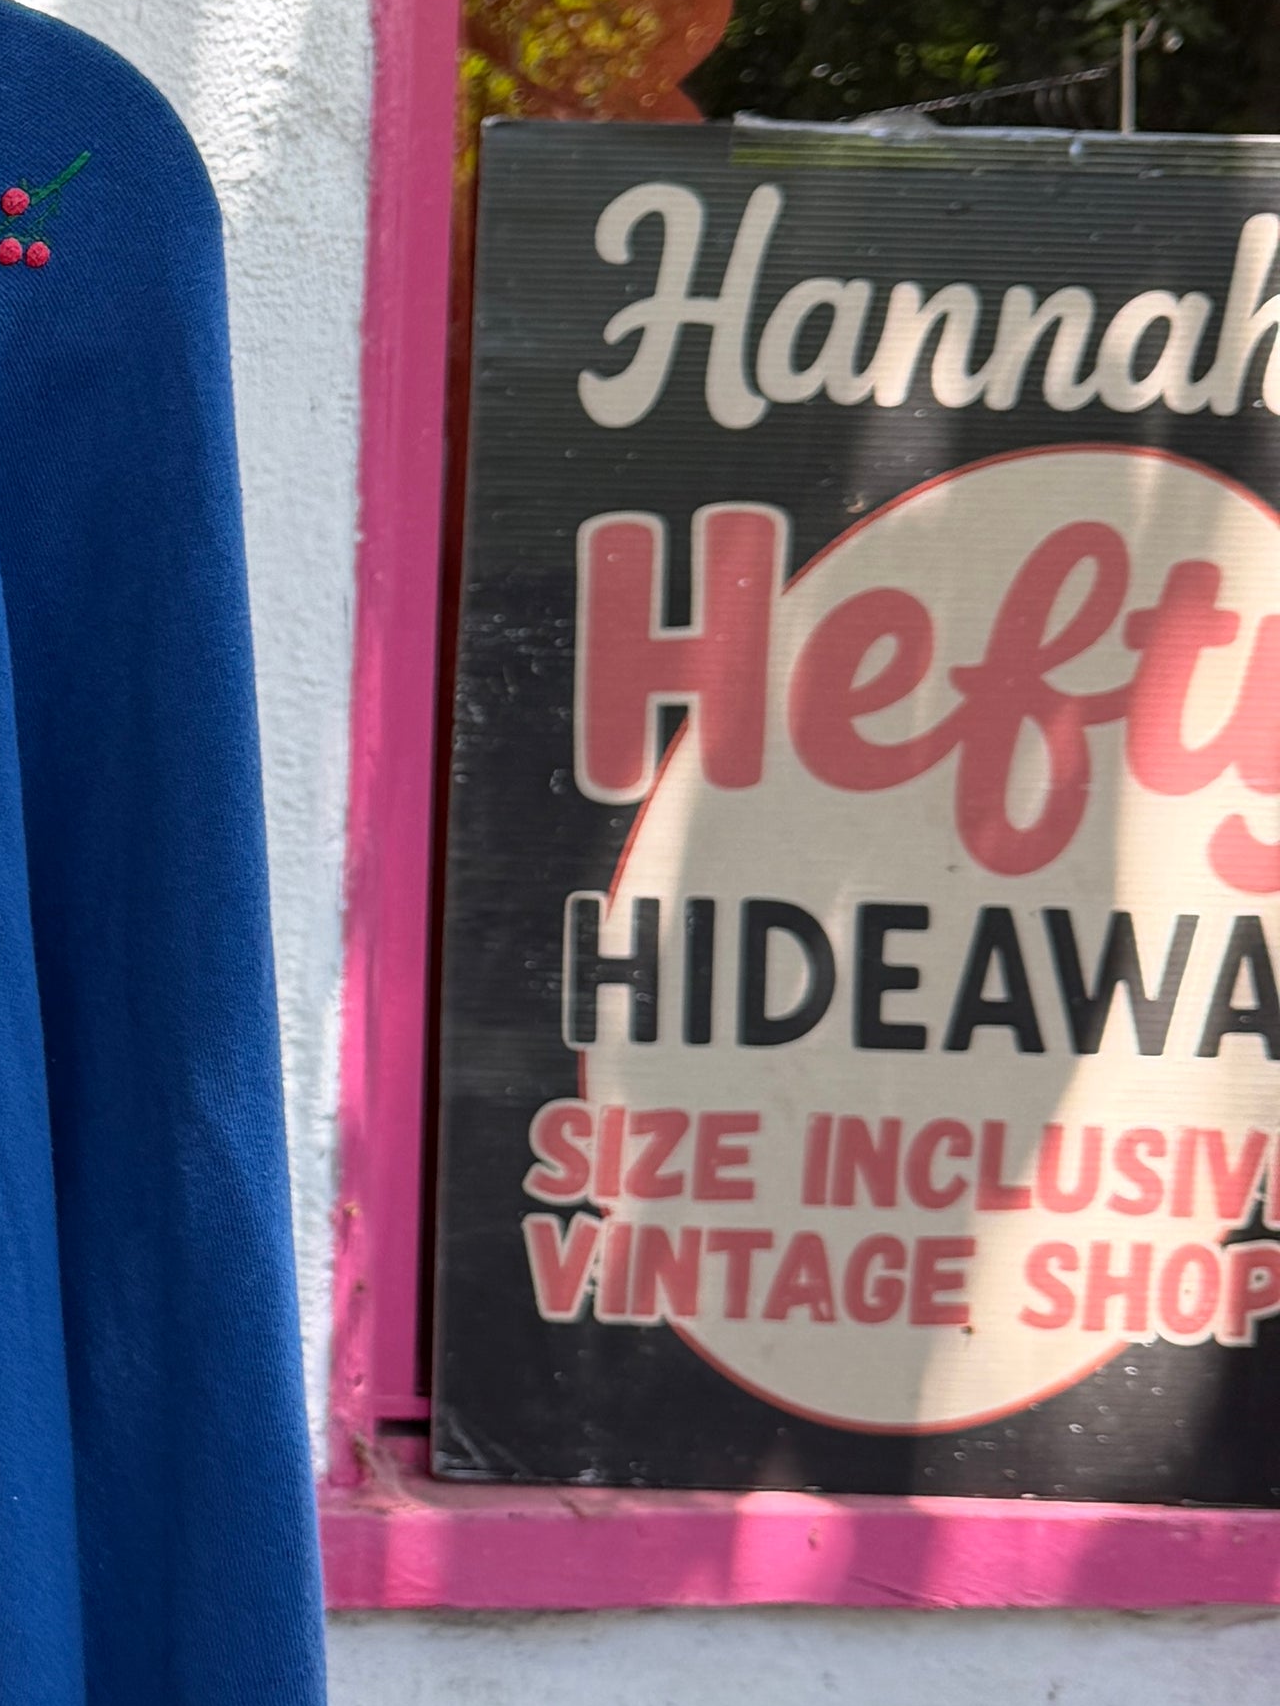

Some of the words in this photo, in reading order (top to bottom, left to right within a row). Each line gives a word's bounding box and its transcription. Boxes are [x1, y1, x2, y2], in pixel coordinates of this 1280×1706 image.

[527, 1101, 761, 1203] SIZE
[800, 1111, 1280, 1223] INCLUSIV
[524, 1217, 976, 1327] VINTAGE
[1016, 1238, 1280, 1339] SHOP
